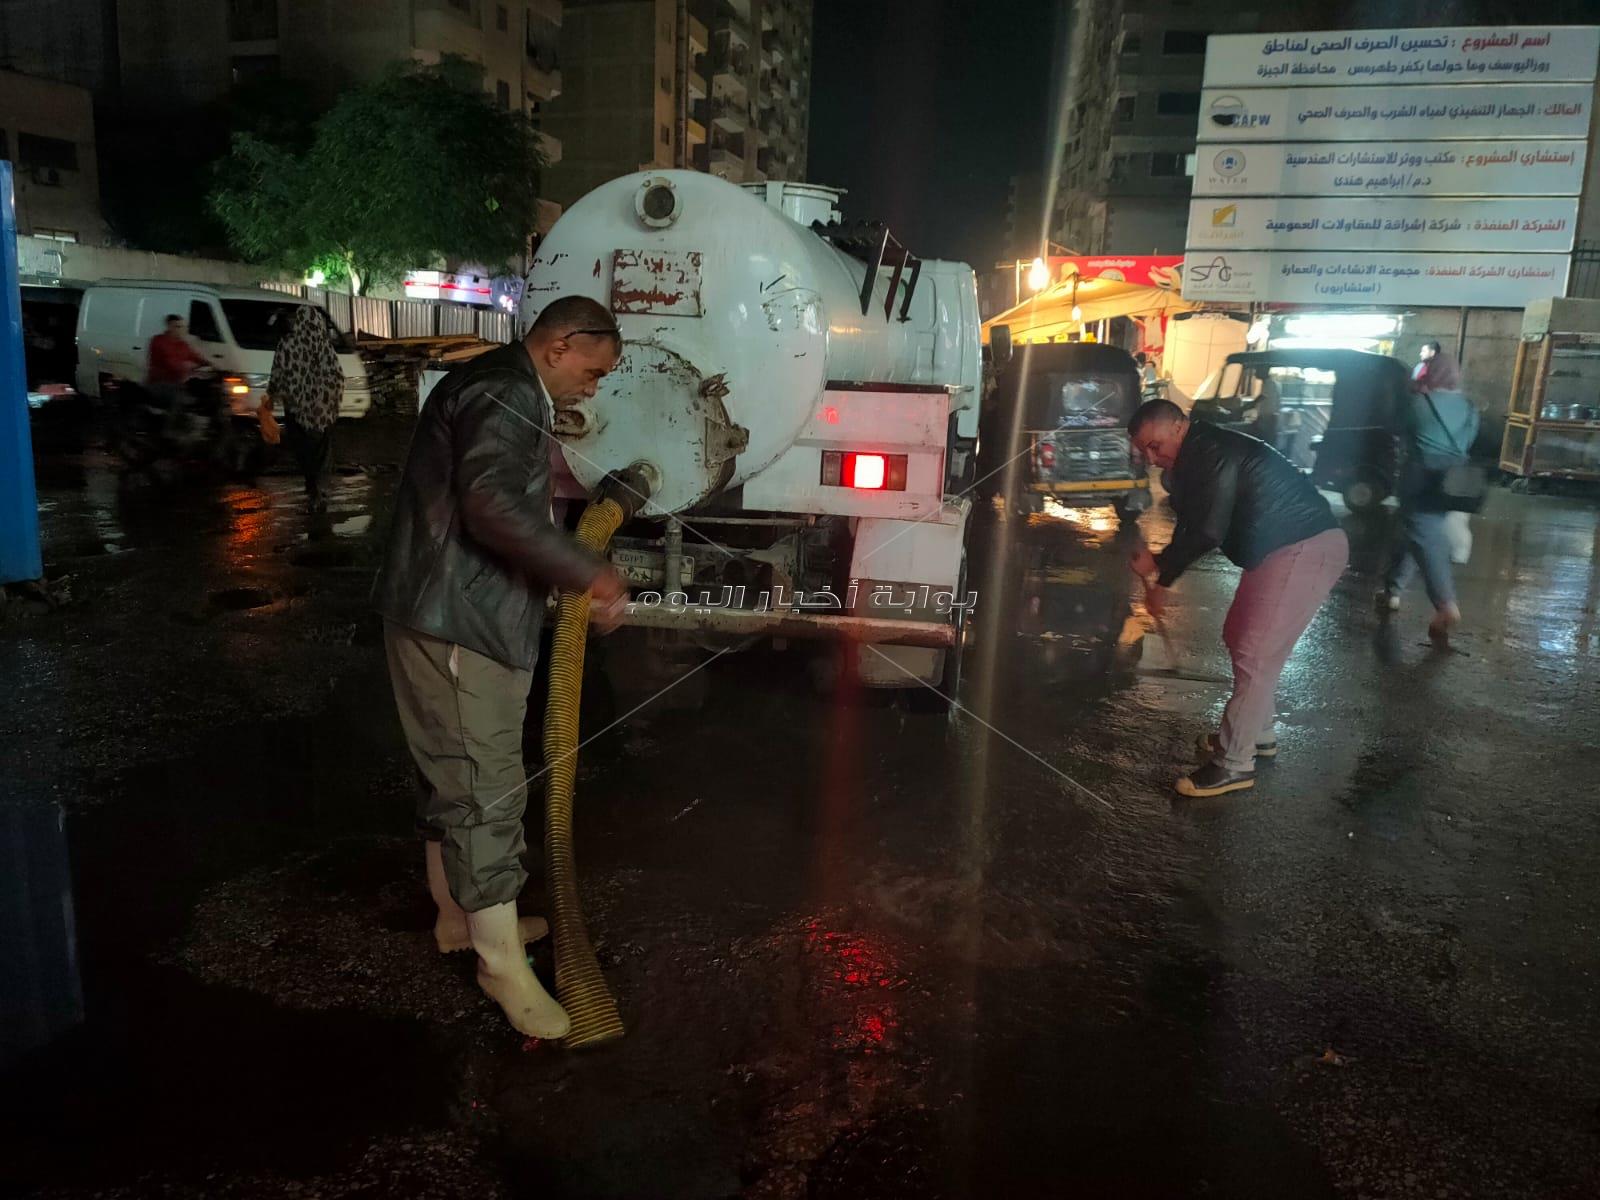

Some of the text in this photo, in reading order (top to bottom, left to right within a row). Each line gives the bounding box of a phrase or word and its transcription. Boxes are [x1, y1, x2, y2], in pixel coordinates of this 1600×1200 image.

[1262, 38, 1309, 55] لمناطق
[1354, 35, 1399, 52] الصرف
[1400, 35, 1449, 51] تحسين
[1461, 32, 1519, 53] المشروع
[1521, 32, 1551, 50] اسم
[1256, 63, 1289, 78] الجيزة
[1291, 62, 1337, 75] محافظة
[1347, 60, 1398, 76] طهرمس
[1399, 60, 1425, 74] بكفر
[1426, 60, 1463, 74] حولها
[1466, 58, 1485, 73] وما
[1334, 106, 1378, 120] والصرف
[1379, 105, 1417, 120] الشرب
[1418, 106, 1448, 120] لمياه
[1496, 104, 1535, 119] الجهاز
[1543, 103, 1582, 117] المالك
[1286, 151, 1336, 168] الهندسية
[1337, 152, 1399, 167] للاستشارات
[1423, 151, 1456, 167] مكتب
[1265, 217, 1320, 234] العمومية
[1321, 218, 1383, 233] للمقاولات
[1428, 218, 1462, 233] شركة
[1473, 219, 1519, 232] المنفذة
[1521, 218, 1566, 234] الشركة
[1281, 263, 1323, 277] والعمارة
[1378, 264, 1421, 278] مجموعة
[1468, 265, 1505, 279] الشركة
